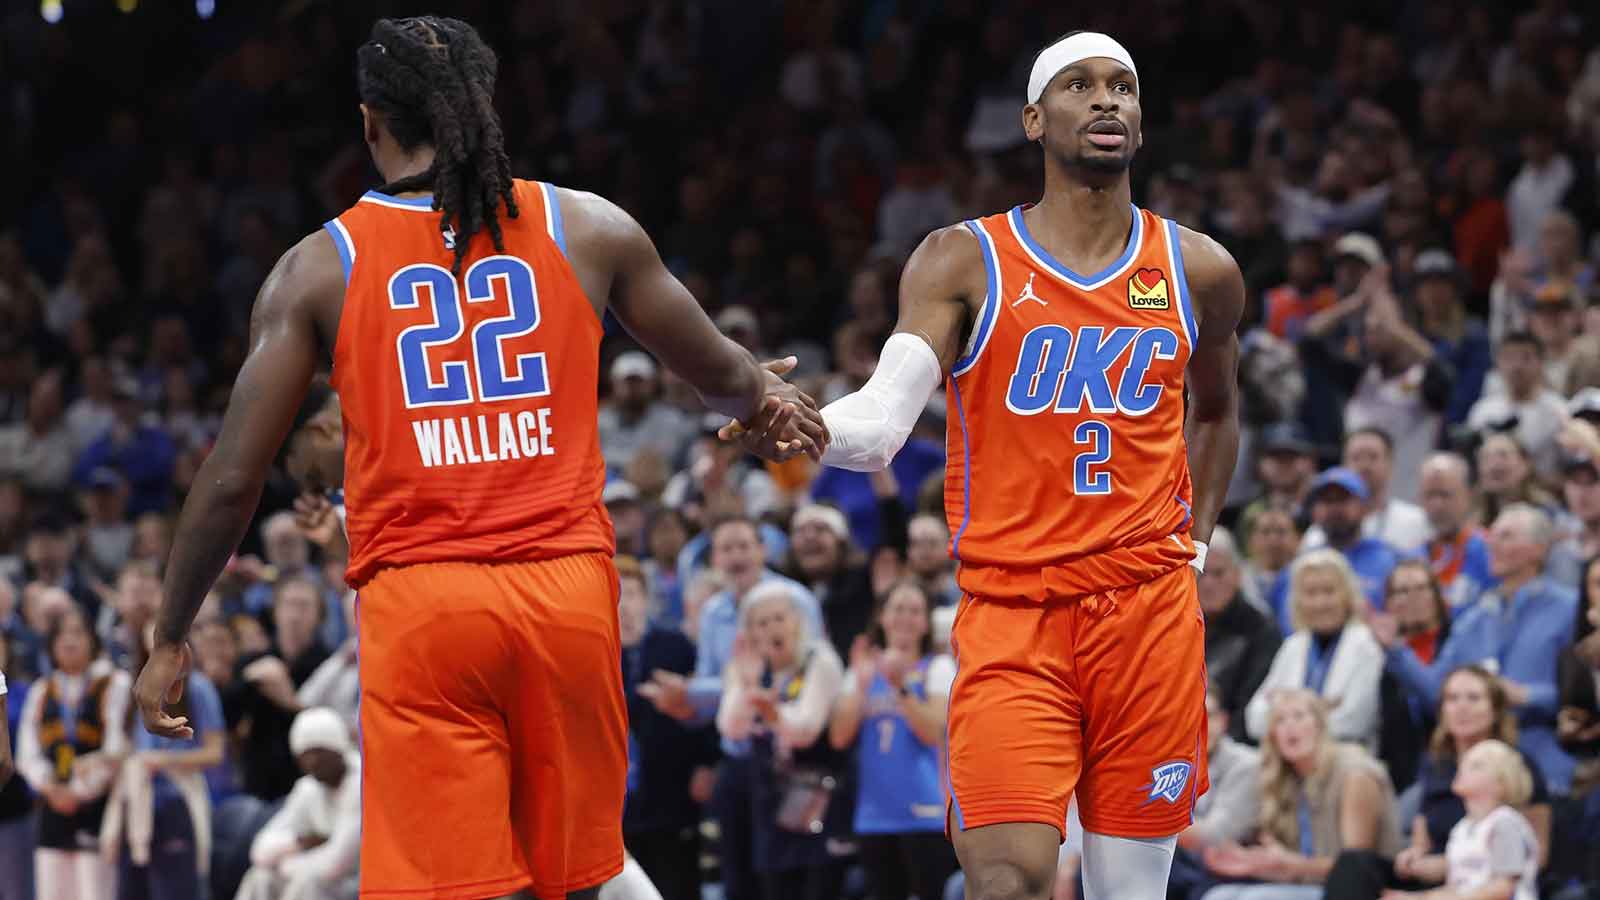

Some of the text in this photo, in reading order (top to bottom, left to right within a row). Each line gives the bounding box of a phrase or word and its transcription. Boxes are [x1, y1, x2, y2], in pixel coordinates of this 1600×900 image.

[387, 255, 550, 409] 22
[1131, 294, 1166, 306] Love's
[1005, 324, 1178, 415] OKC
[412, 408, 554, 467] WALLACE
[1073, 420, 1111, 494] 2
